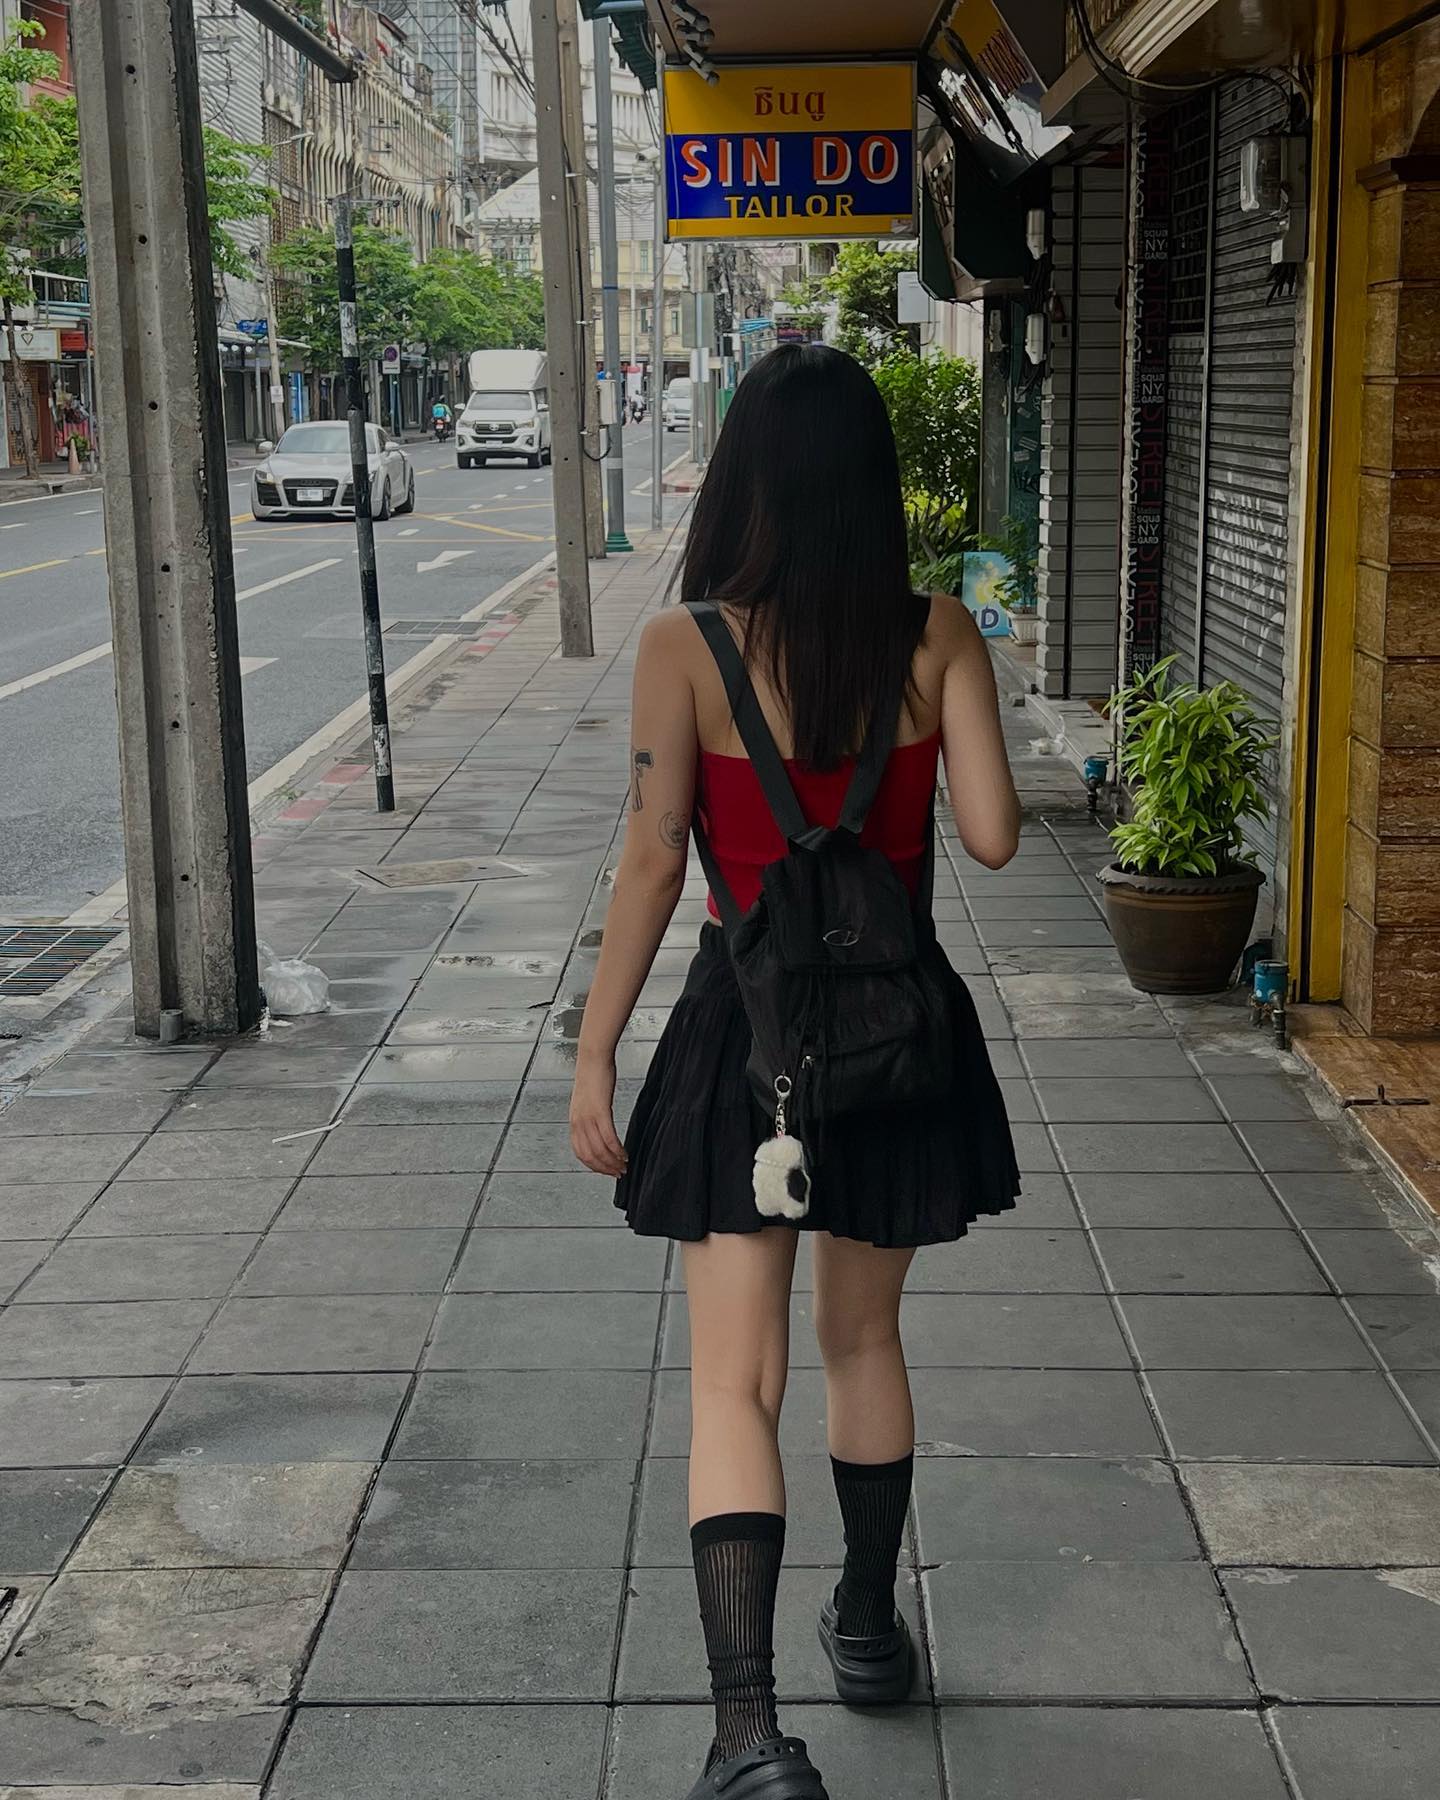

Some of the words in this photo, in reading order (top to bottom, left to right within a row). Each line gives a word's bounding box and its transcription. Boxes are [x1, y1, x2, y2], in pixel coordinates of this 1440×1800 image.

[681, 137, 780, 187] SIN
[812, 136, 898, 186] DO
[724, 194, 855, 218] TAILOR
[1138, 524, 1159, 536] NY
